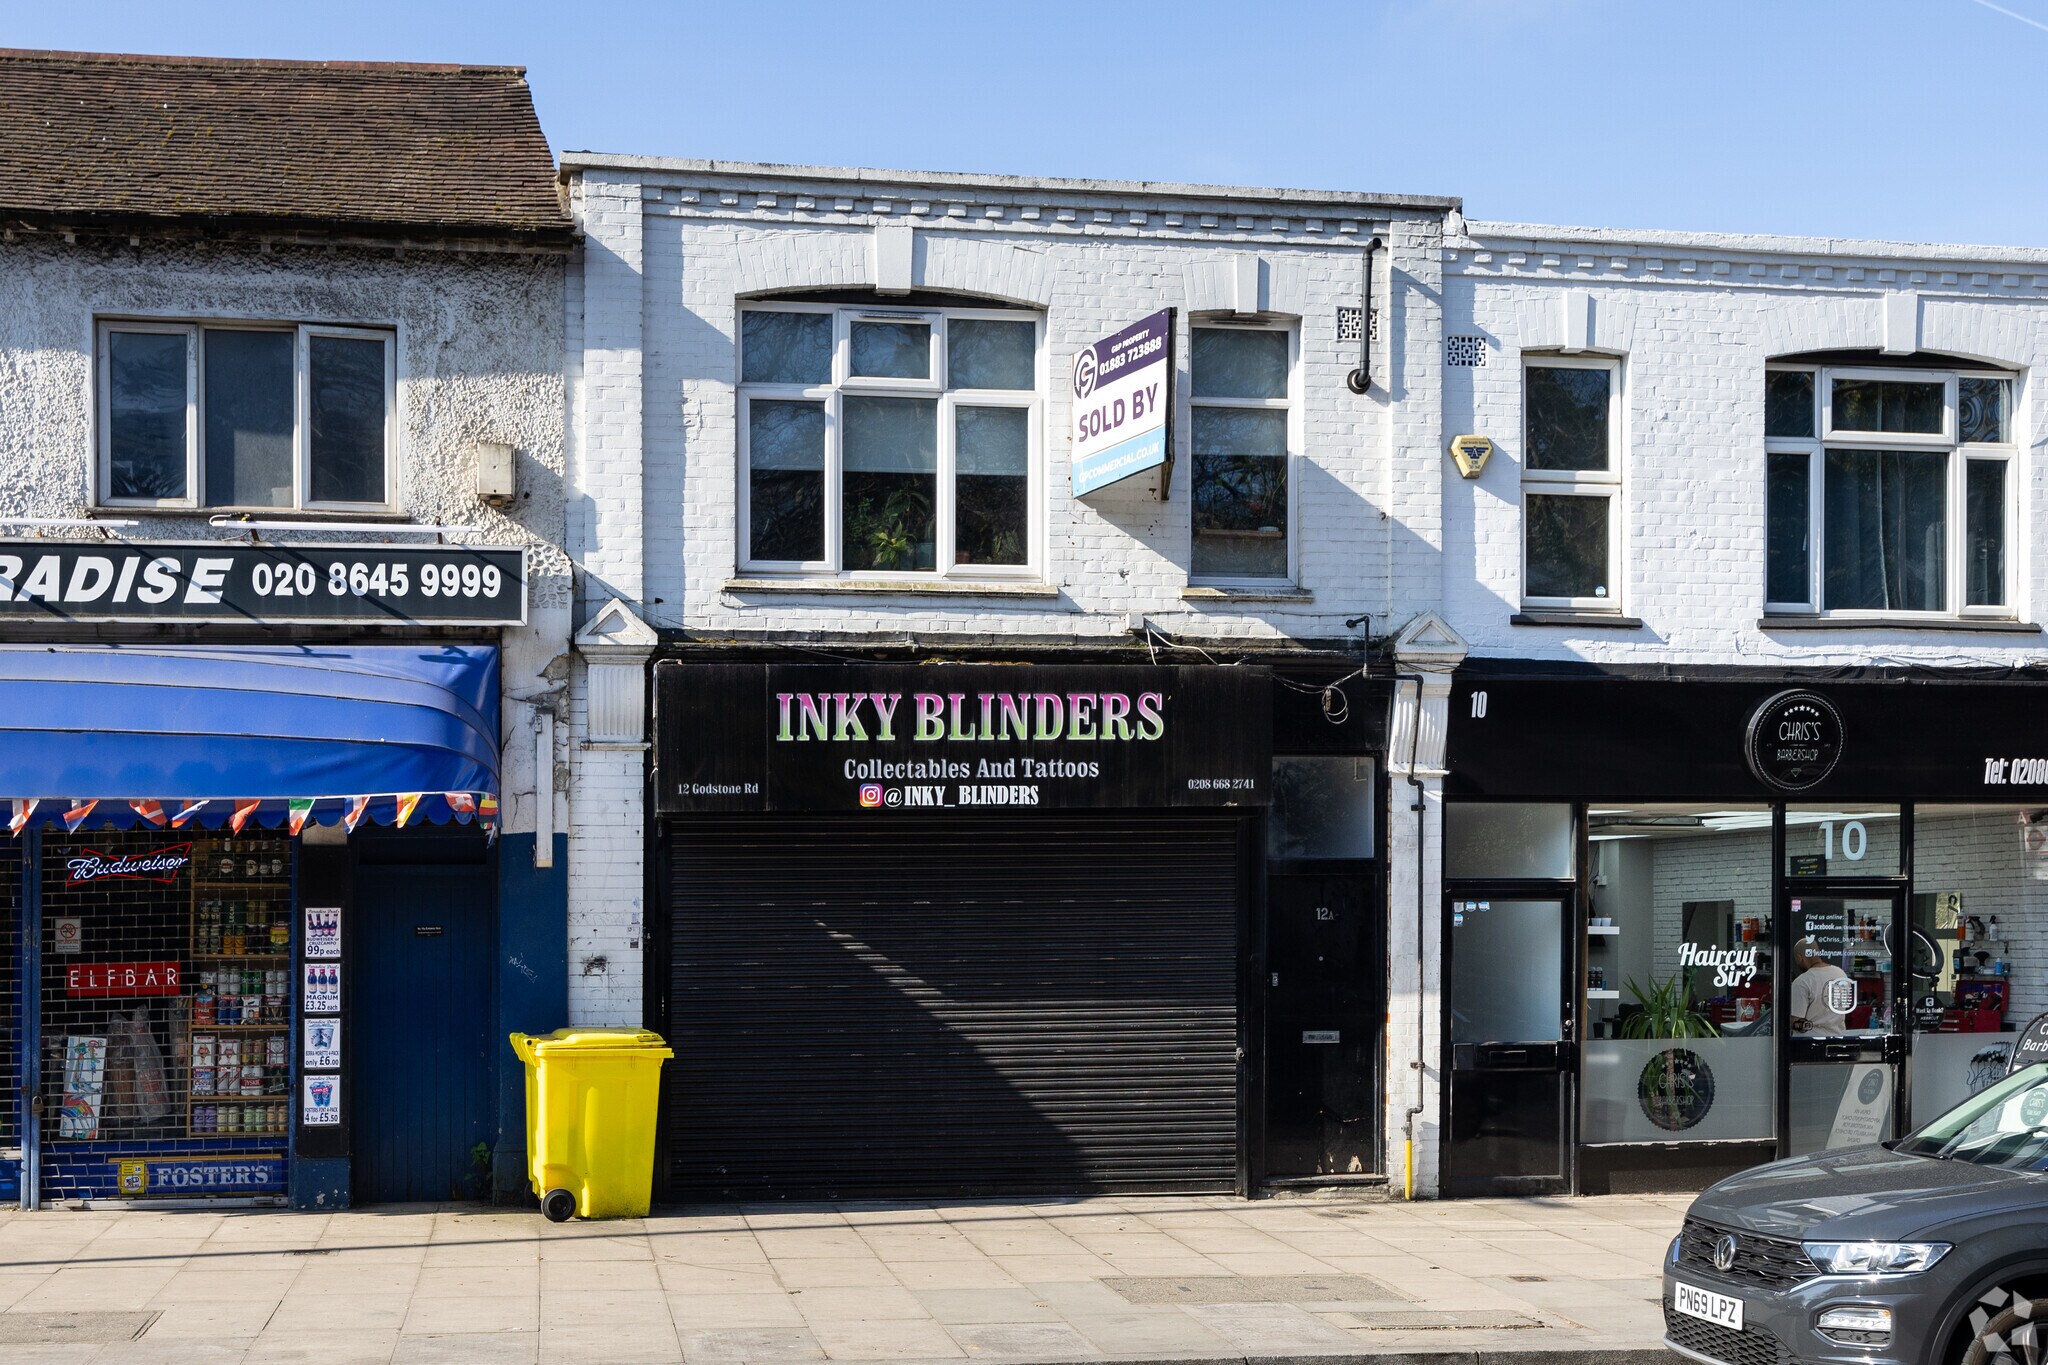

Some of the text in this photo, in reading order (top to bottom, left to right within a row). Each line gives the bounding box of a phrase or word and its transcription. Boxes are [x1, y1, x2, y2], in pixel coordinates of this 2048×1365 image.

[1122, 329, 1150, 350] PROPERTY
[1099, 336, 1162, 377] 01883 723888
[1078, 382, 1158, 443] SOLD BY
[252, 562, 316, 597] 020
[327, 562, 410, 597] 8645
[420, 563, 501, 598] 9999
[1471, 691, 1488, 718] 10
[776, 692, 1165, 741] INKY BLINDERS
[1778, 721, 1822, 741] CHRIS'S
[1776, 748, 1819, 761] BARBERSHOP
[843, 758, 1099, 779] Collectables And Tattoos
[1984, 758, 2009, 784] Tel:
[677, 782, 759, 795] 12 Godstone Rd
[1187, 778, 1255, 789] 0208 668 2741
[958, 785, 1039, 805] BLINDERS
[1819, 821, 1867, 861] 10
[67, 854, 189, 880] Budweiser
[307, 945, 325, 957] 99p
[1677, 942, 1758, 967] Haircut
[70, 968, 177, 988] ELFBAR
[1713, 963, 1757, 989] Sir?
[305, 1001, 327, 1010] £3.25
[319, 1056, 339, 1066] £6.00
[305, 1113, 310, 1122] 4
[319, 1113, 338, 1122] £5.50
[156, 1165, 269, 1187] FOSTER'S
[1679, 1287, 1736, 1324] PN69 LPZ
